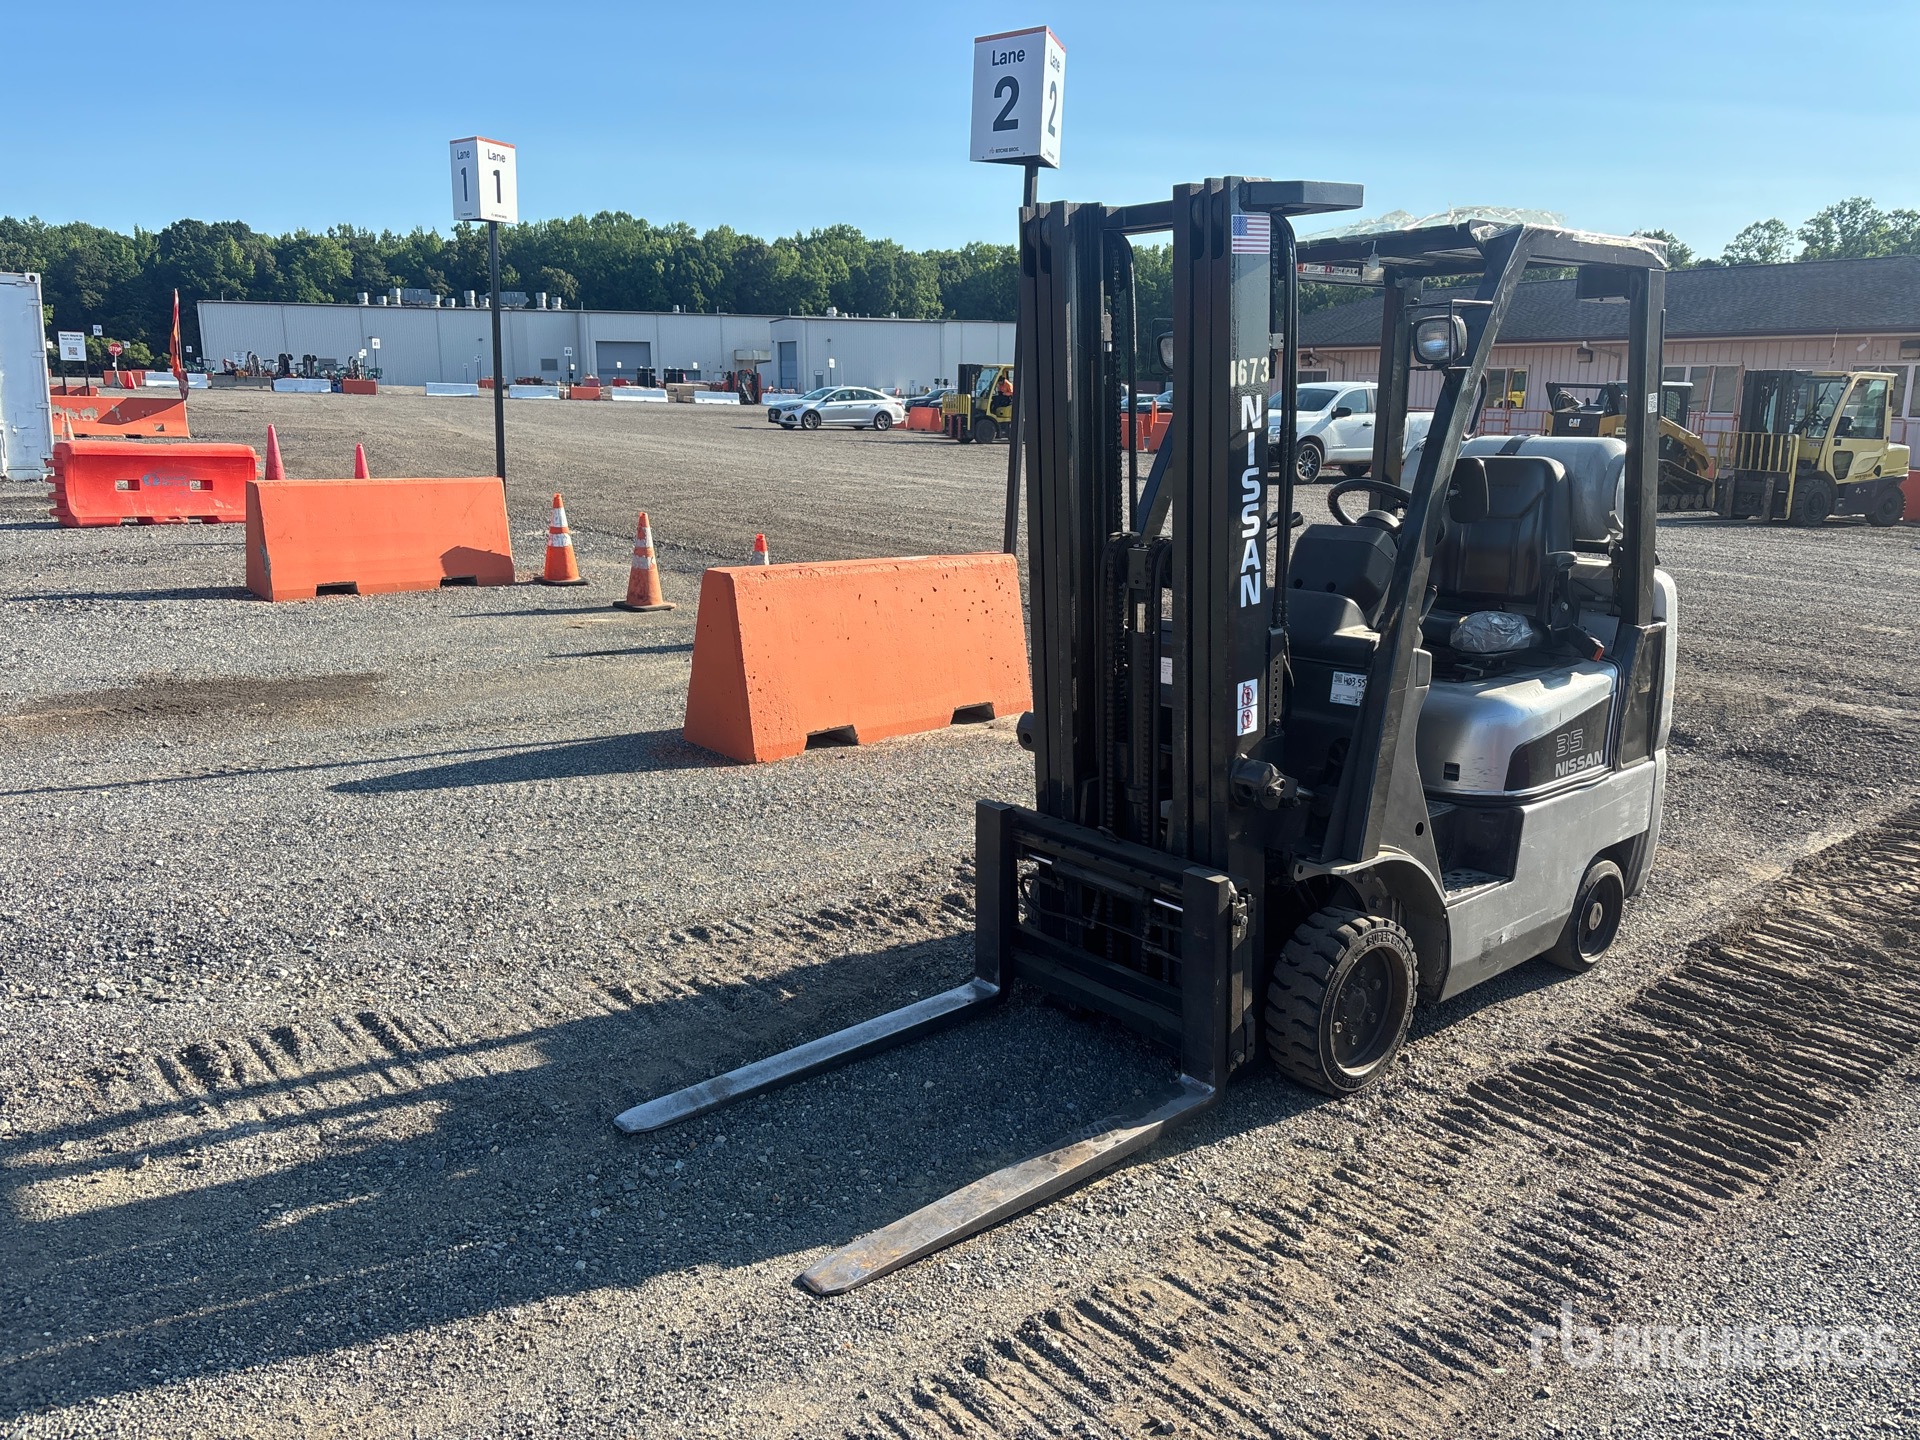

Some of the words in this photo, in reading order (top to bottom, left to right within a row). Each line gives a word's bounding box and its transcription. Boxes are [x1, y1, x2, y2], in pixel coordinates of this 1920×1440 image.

[991, 49, 1026, 66] Lane
[1049, 48, 1061, 73] Lane
[992, 75, 1020, 132] 2
[1047, 80, 1057, 138] 2
[456, 149, 471, 160] Lane
[487, 148, 506, 163] Lane
[460, 166, 468, 202] 1
[492, 169, 502, 204] 1
[1230, 356, 1270, 388] 1673
[1568, 418, 1581, 427] CAT
[1240, 394, 1262, 608] NISSAN
[1556, 728, 1584, 758] 35
[1555, 749, 1603, 777] NISSAN
[1366, 931, 1391, 945] SUPER
